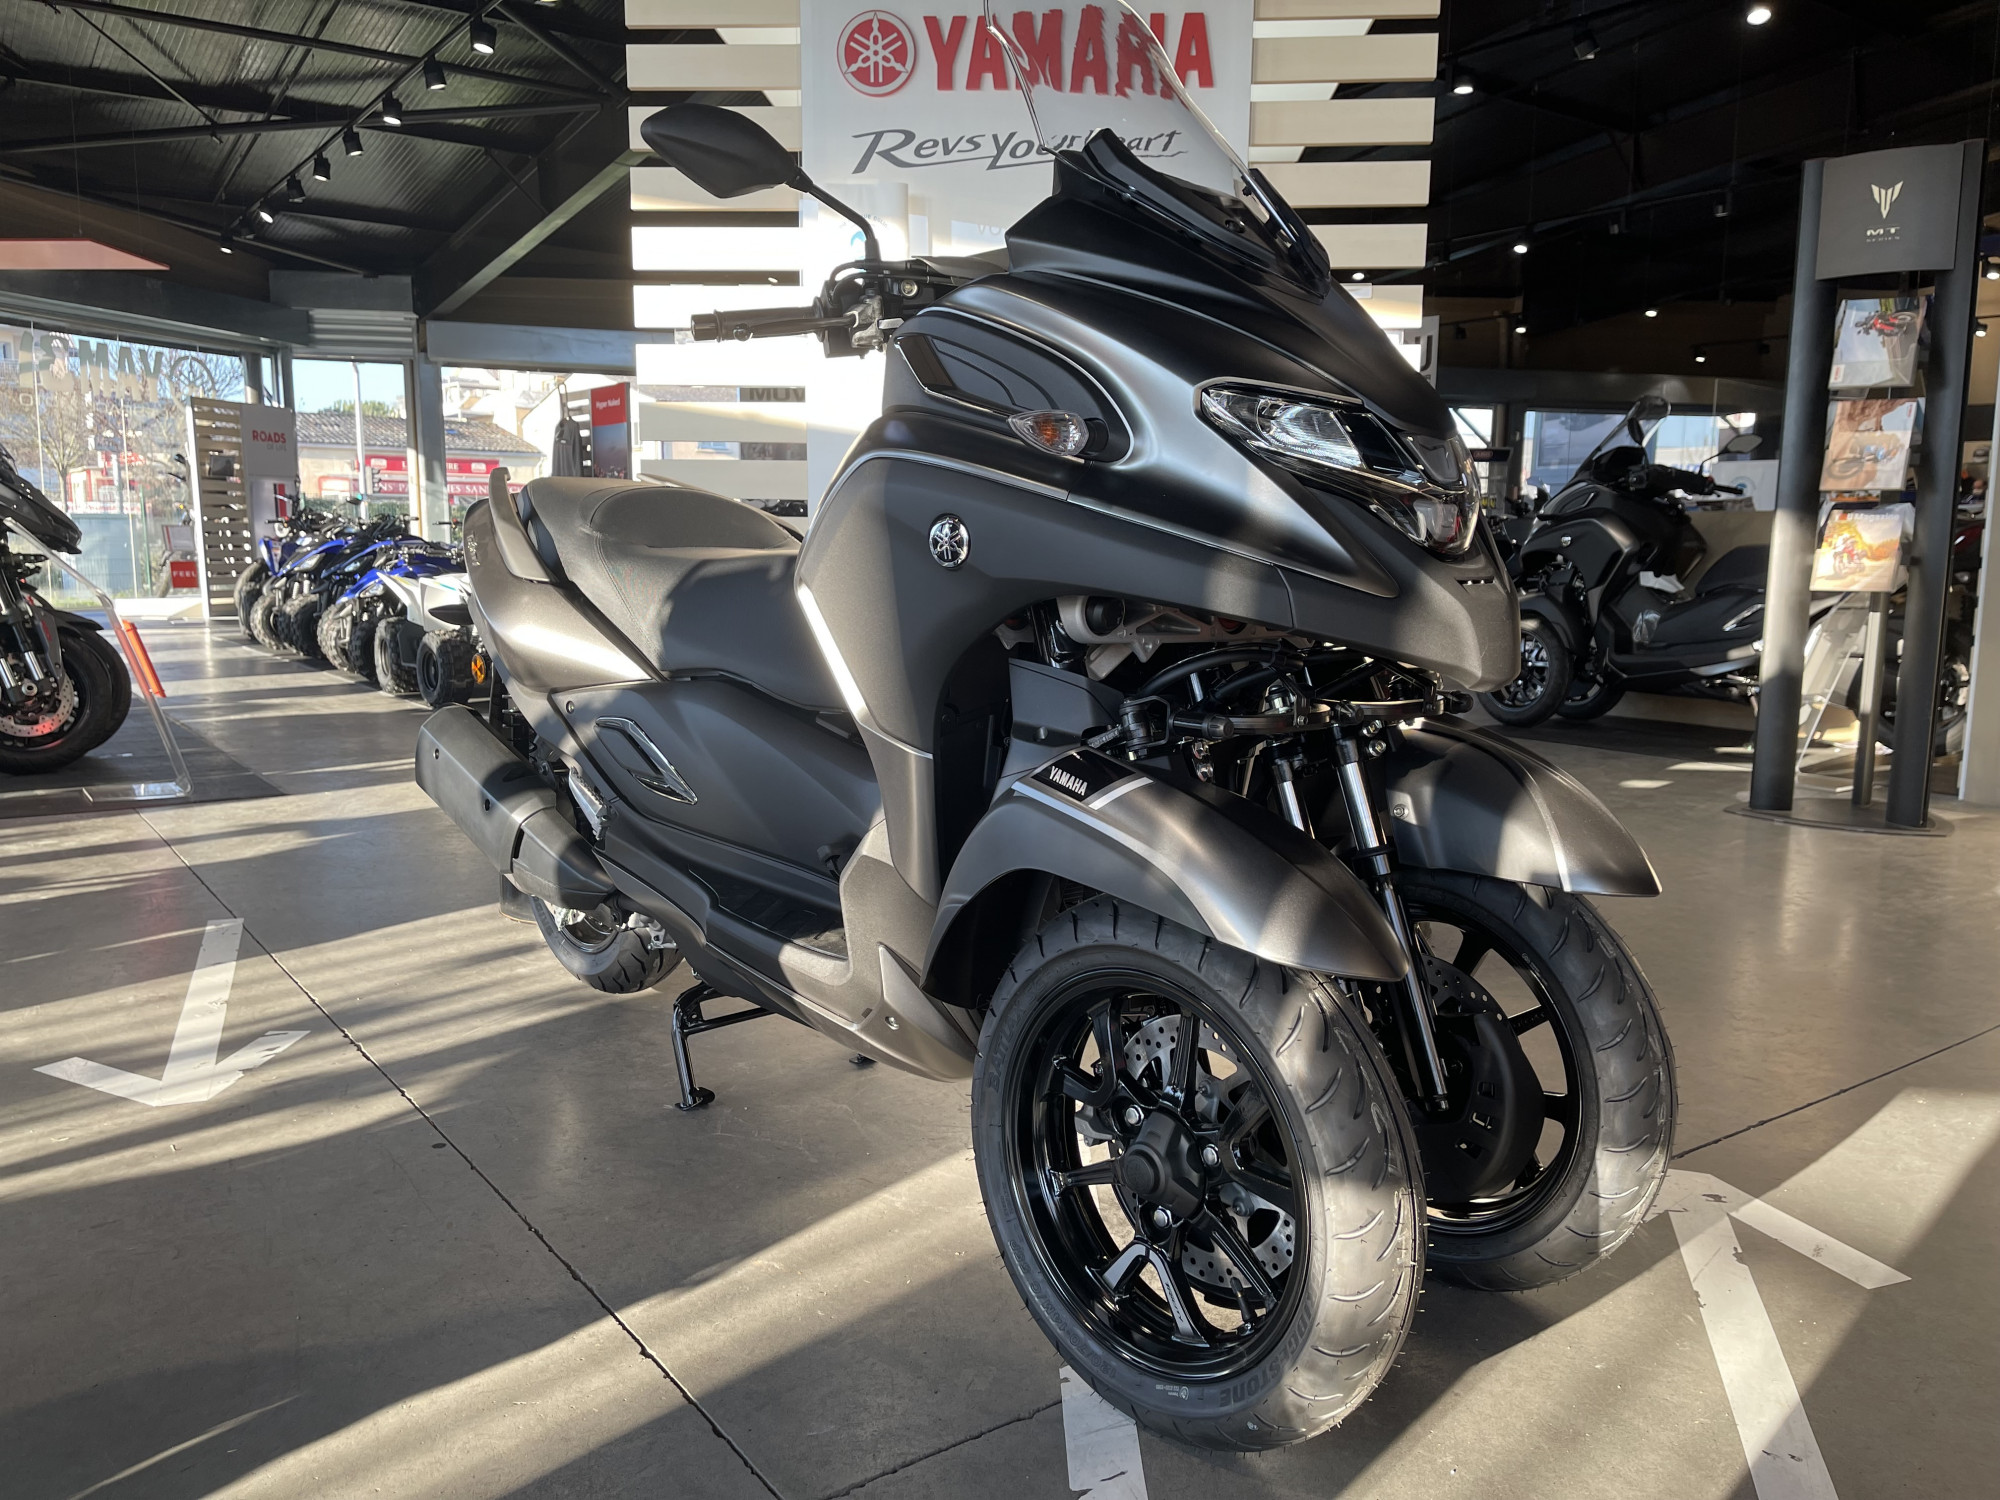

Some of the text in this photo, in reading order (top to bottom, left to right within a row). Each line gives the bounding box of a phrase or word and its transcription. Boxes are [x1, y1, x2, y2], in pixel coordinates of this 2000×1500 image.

[923, 5, 1214, 99] YAMAHA
[851, 129, 986, 174] Revs
[252, 429, 287, 444] ROADS
[172, 570, 197, 578] FEEL
[1050, 765, 1089, 796] YAMAHA
